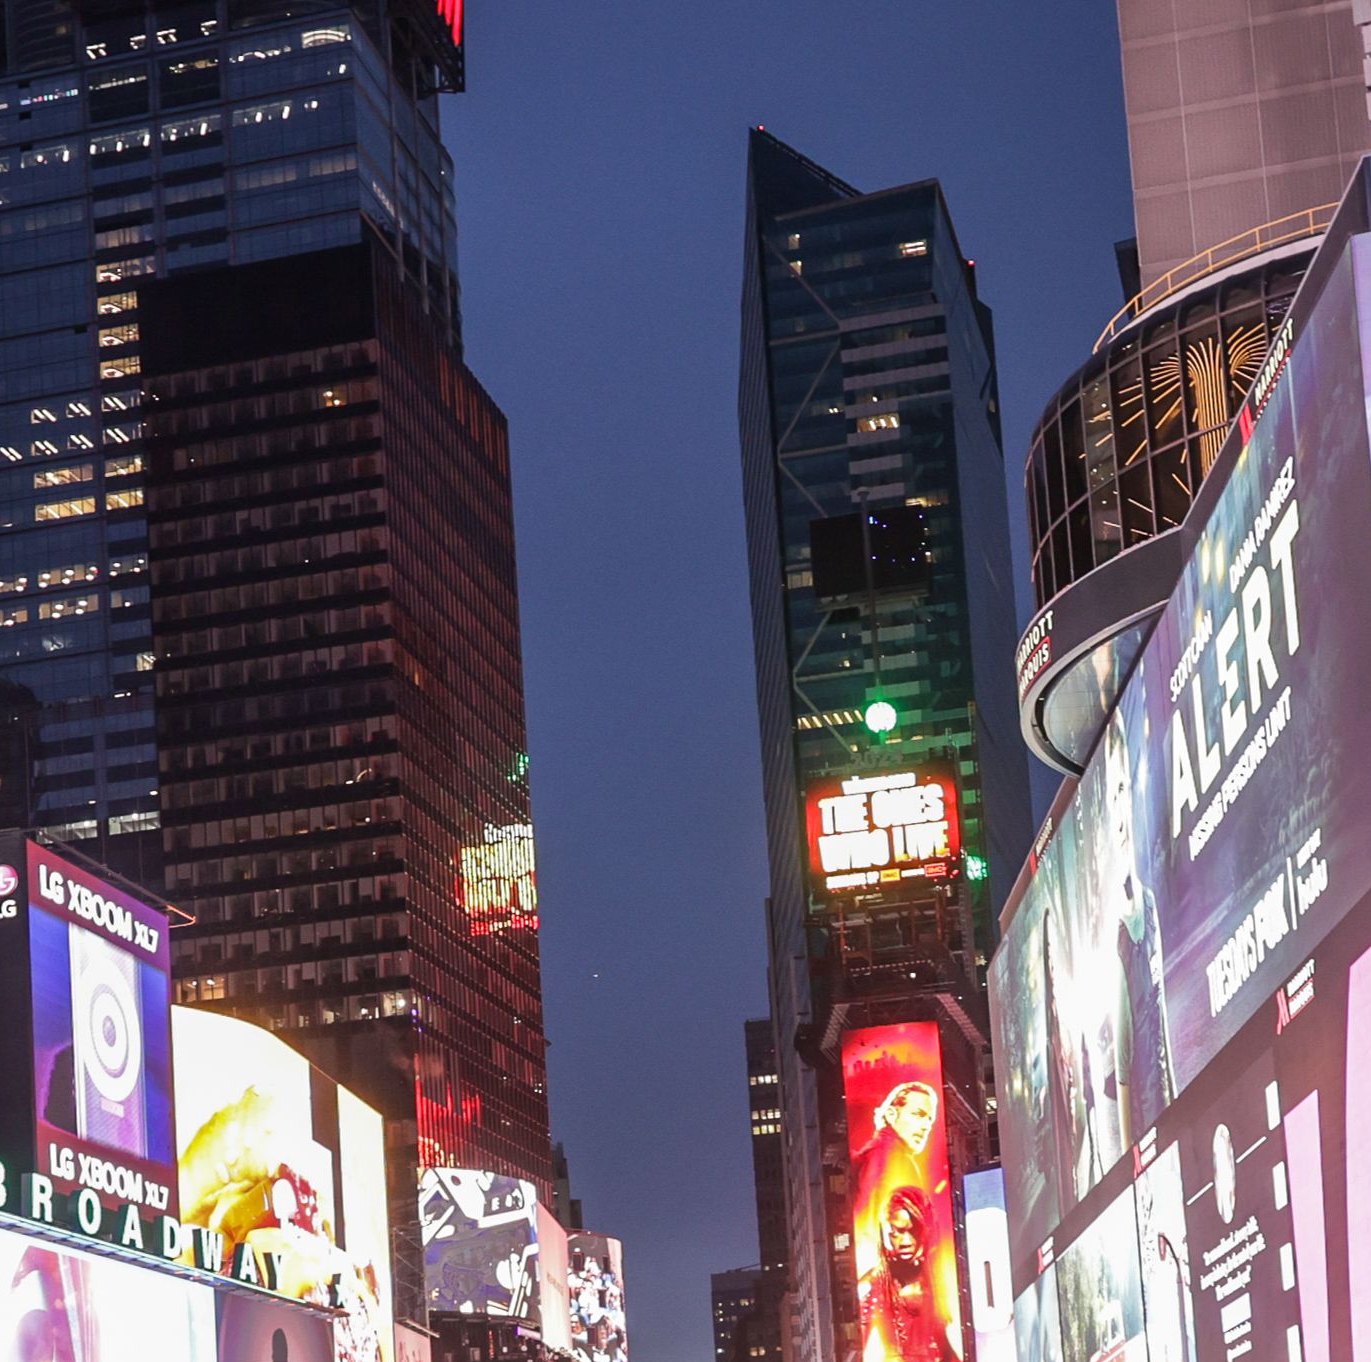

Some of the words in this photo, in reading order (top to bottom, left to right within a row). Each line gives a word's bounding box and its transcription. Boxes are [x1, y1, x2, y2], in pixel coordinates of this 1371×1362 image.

[1172, 499, 1300, 838] ALERT
[38, 864, 63, 905] LG
[68, 880, 133, 937] XBOOM
[135, 920, 160, 954] XL7
[49, 1143, 75, 1181] LG
[79, 1153, 143, 1205] XBOOM
[145, 1177, 169, 1210] XL7
